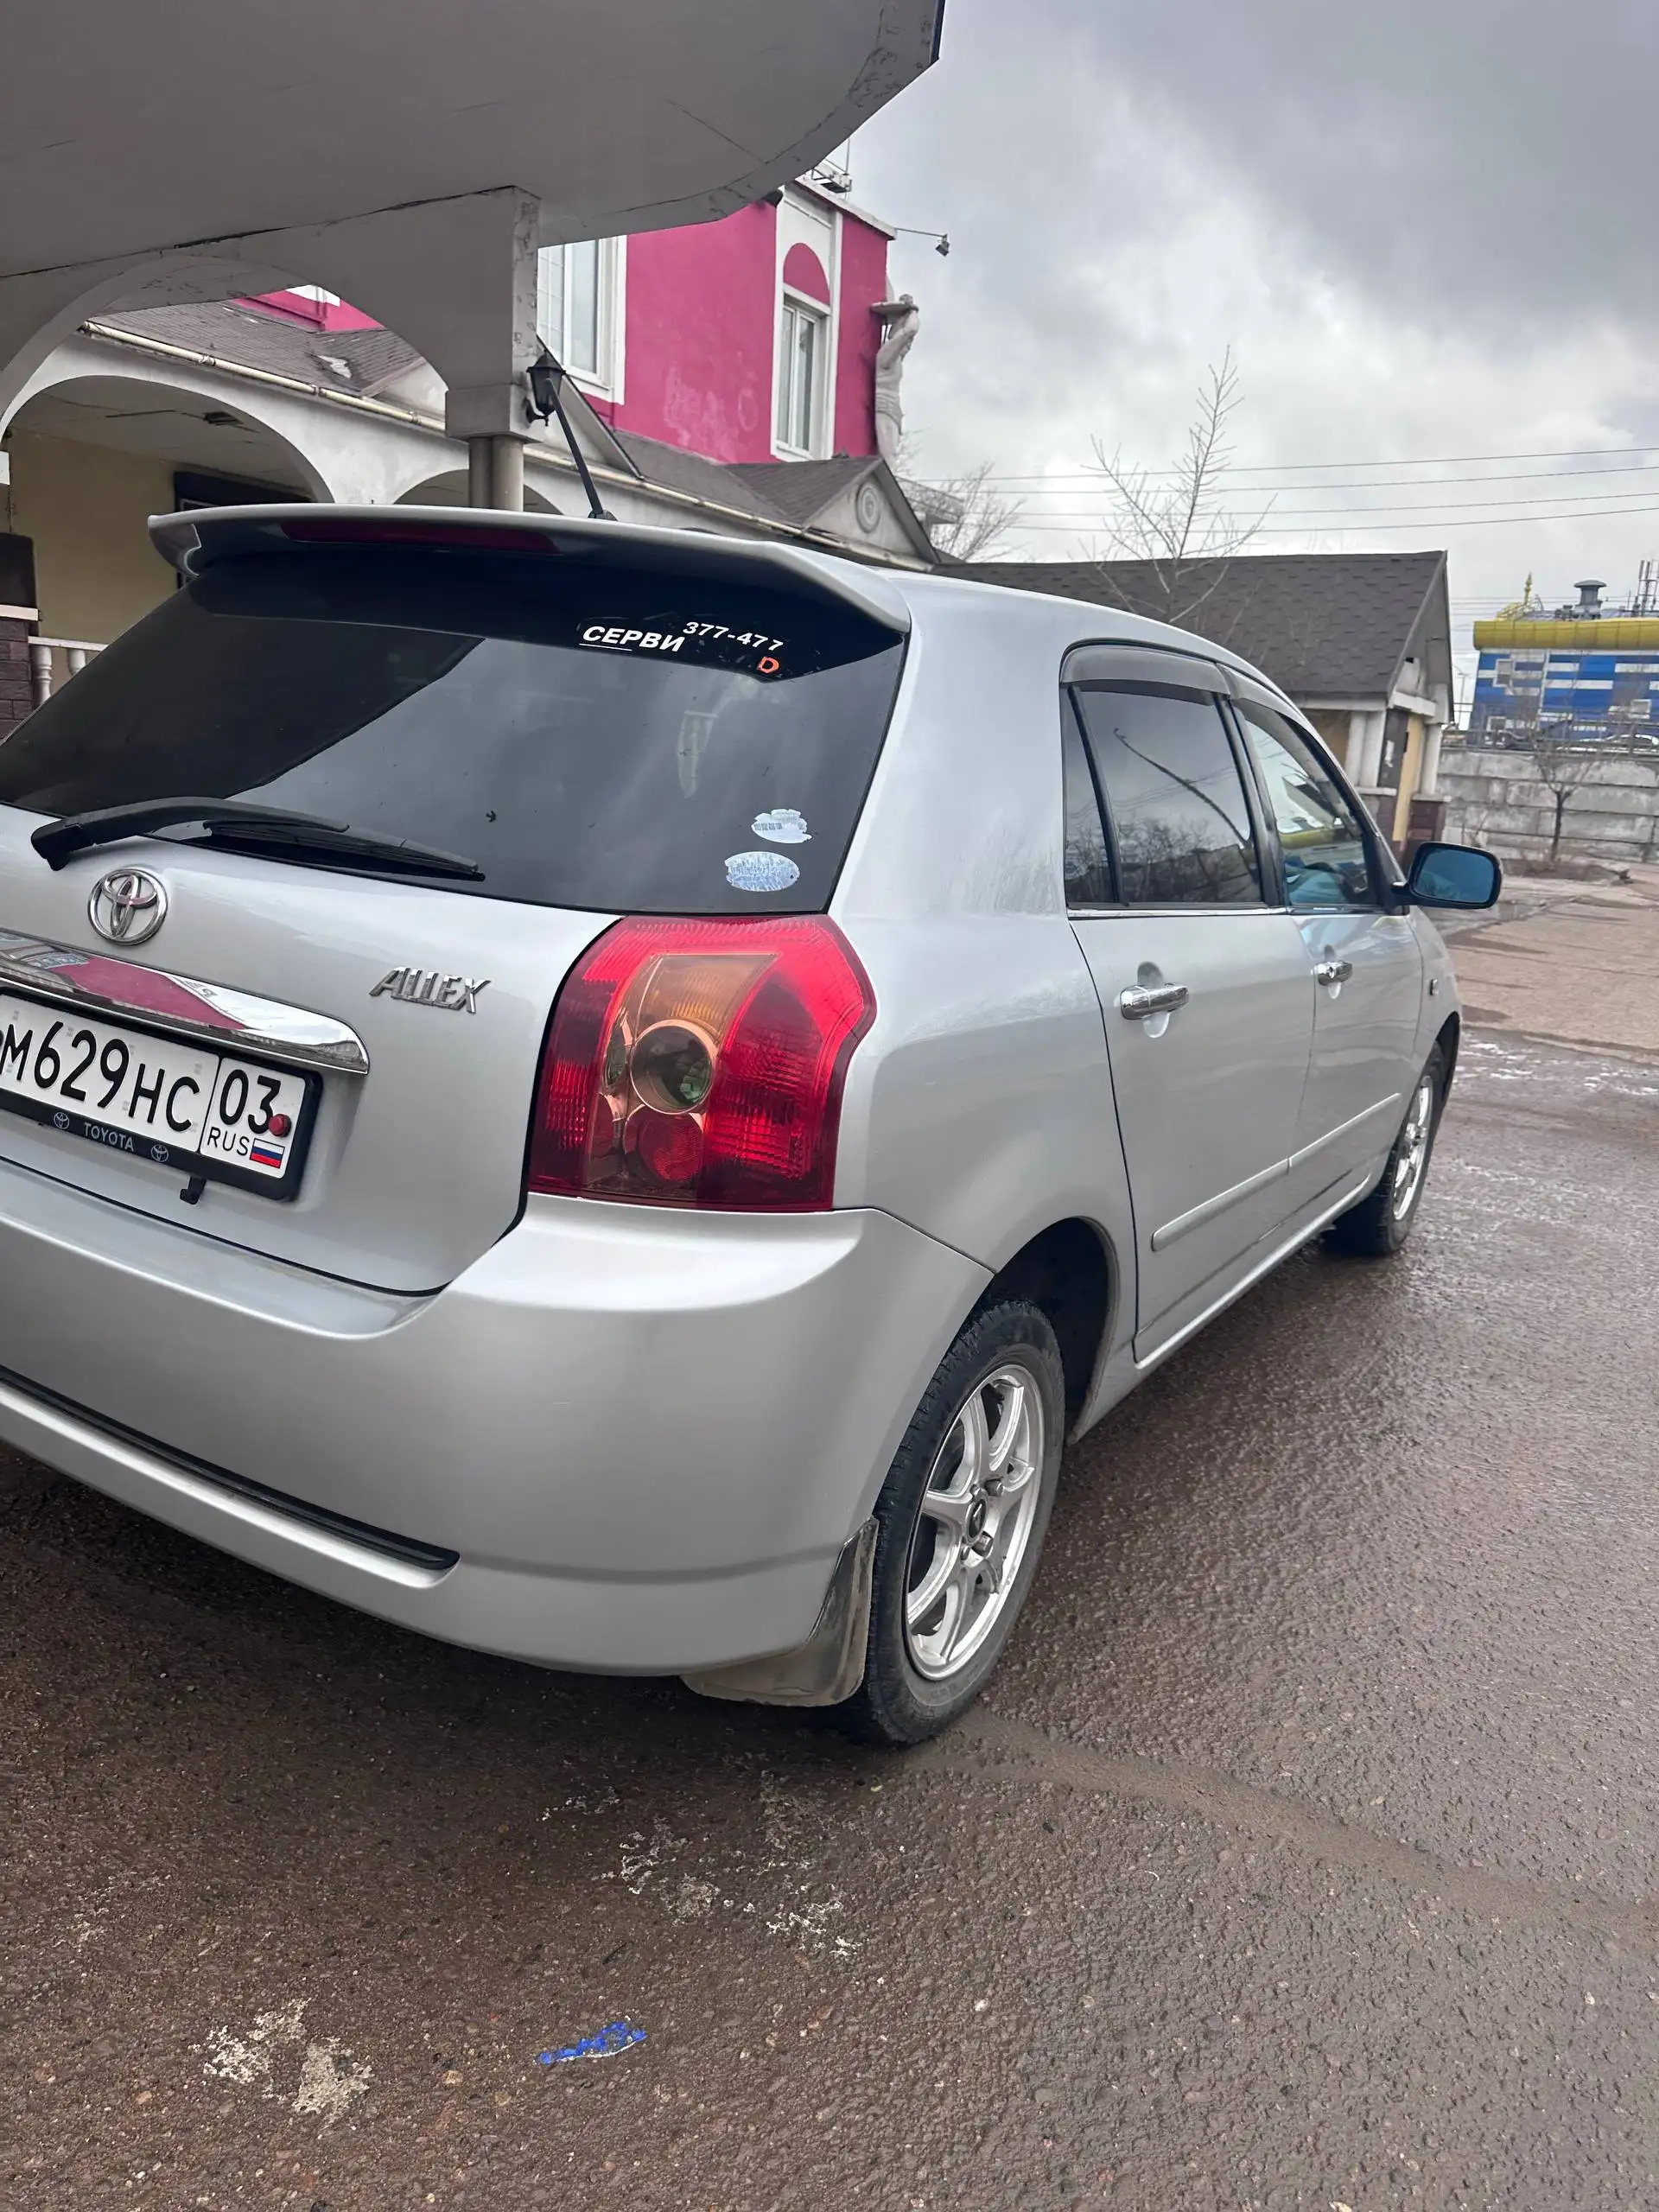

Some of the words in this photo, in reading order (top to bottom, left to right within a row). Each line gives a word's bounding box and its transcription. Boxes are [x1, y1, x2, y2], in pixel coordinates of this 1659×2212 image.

[582, 626, 685, 652] СЕРВИ
[683, 621, 784, 652] 377-477
[369, 966, 492, 1014] ALLEX
[219, 1068, 282, 1135] 03
[84, 1122, 136, 1152] TOYOTA
[207, 1126, 251, 1156] RUS
